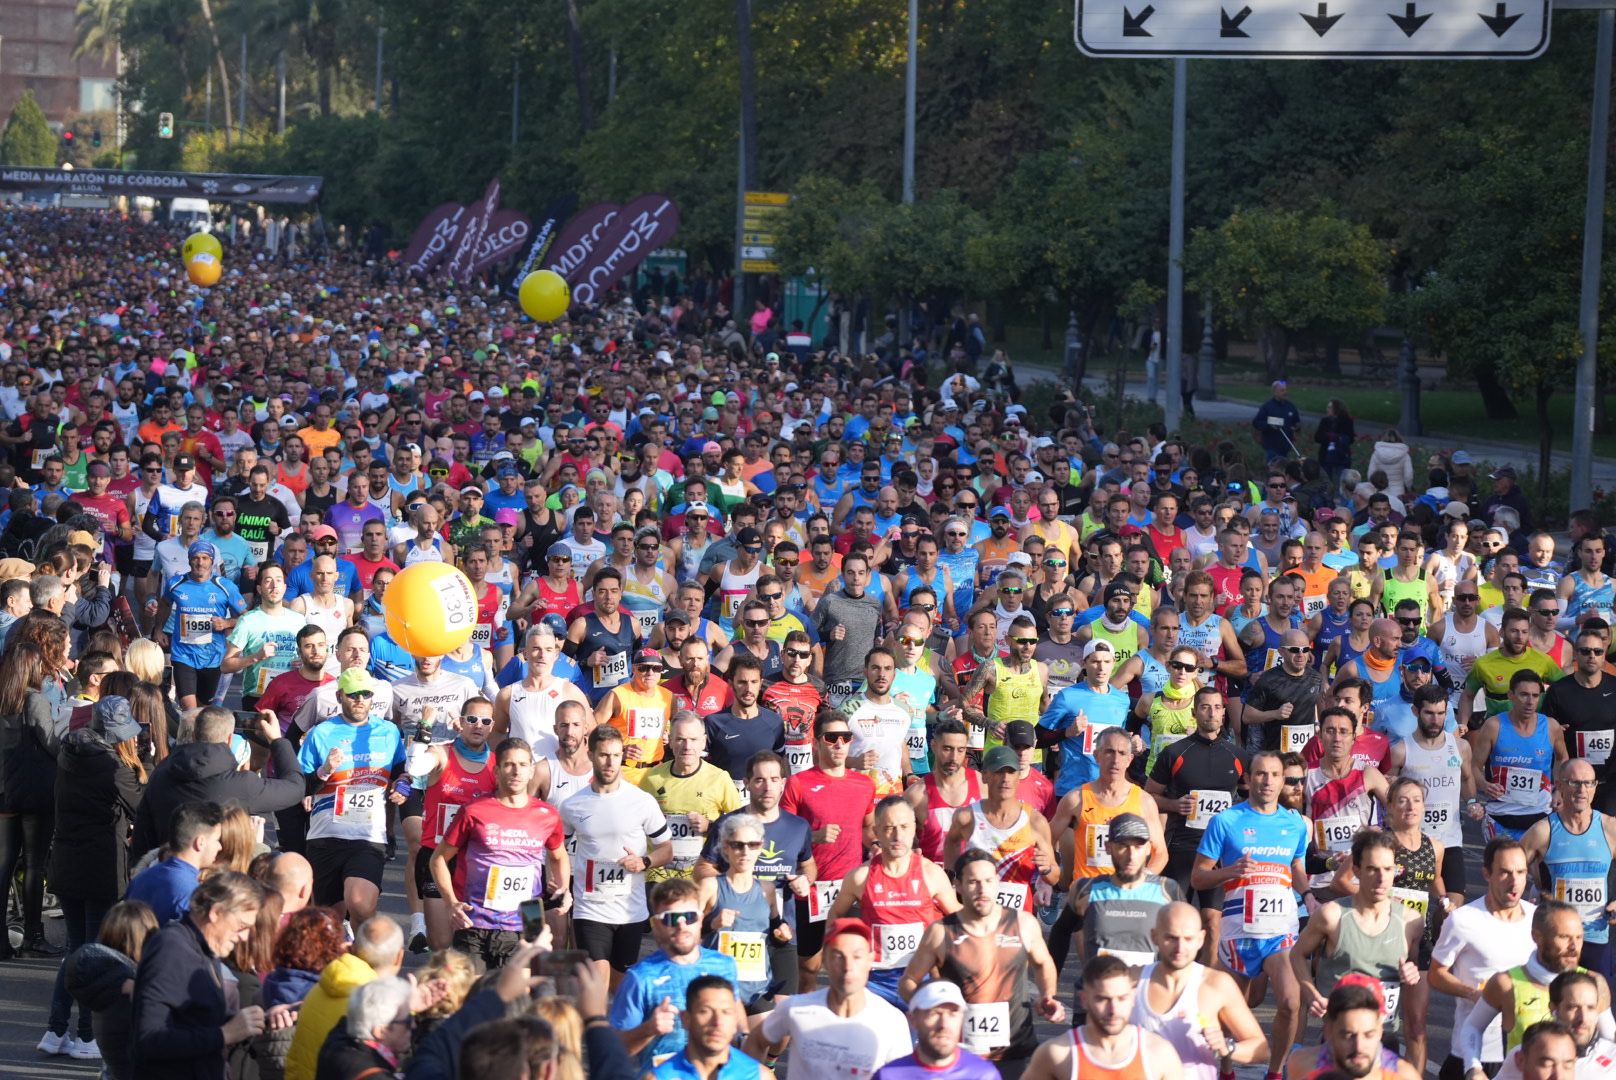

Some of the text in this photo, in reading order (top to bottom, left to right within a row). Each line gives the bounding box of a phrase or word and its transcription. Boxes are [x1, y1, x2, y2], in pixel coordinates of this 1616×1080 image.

[2, 170, 189, 187] MEDIA MARATÓN DE CÓRDOBA
[71, 184, 102, 192] SALIDA
[238, 512, 271, 527] ÁNIMO
[240, 527, 266, 540] RAÚL
[180, 606, 217, 614] TROTASIERRA
[439, 582, 464, 624] 1:30
[1307, 600, 1324, 612] 380
[186, 620, 211, 632] 1958
[471, 630, 490, 641] 869
[1115, 648, 1132, 662] ght
[602, 659, 626, 675] 1189
[827, 684, 851, 696] 2008
[327, 705, 338, 716] LA
[907, 736, 925, 749] 432
[1291, 732, 1311, 745] 901
[1589, 737, 1611, 751] 465
[1494, 754, 1533, 765] enerplus
[1423, 775, 1455, 788] NDEA
[1510, 775, 1534, 790] 331
[349, 794, 374, 808] 425
[1198, 798, 1229, 813] 1423
[1424, 809, 1448, 823] 595
[501, 829, 529, 838] MEDIA
[486, 837, 544, 848] 36 MARATÓN
[1241, 845, 1292, 858] enerplus
[598, 868, 625, 883] 144
[1256, 863, 1285, 874] aratón
[503, 876, 528, 891] 962
[996, 891, 1023, 909] 578
[1566, 888, 1602, 903] 1860
[1258, 898, 1284, 913] 211
[730, 941, 762, 959] 1757
[887, 935, 916, 951] 388
[968, 1015, 1000, 1033] 142
